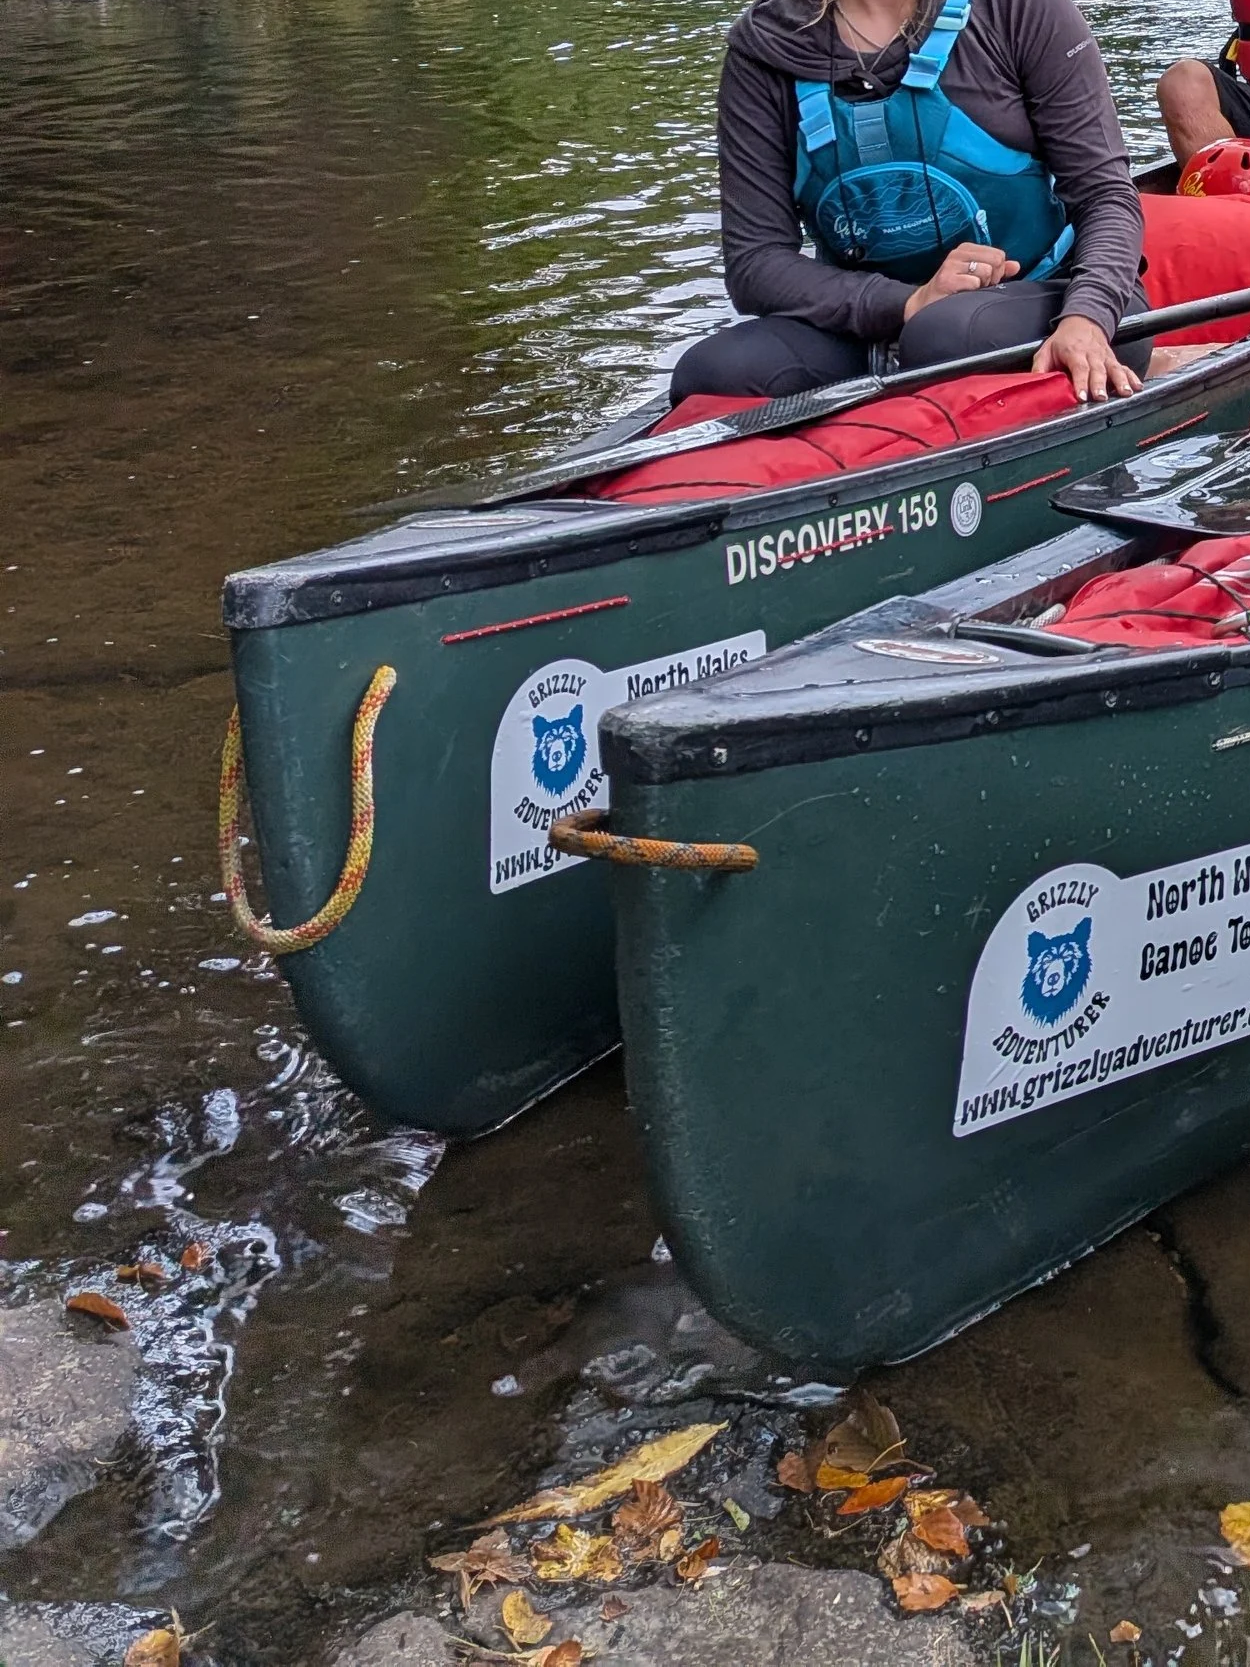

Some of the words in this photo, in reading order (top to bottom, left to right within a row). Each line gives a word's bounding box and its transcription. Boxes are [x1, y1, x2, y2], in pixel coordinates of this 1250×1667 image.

[726, 502, 889, 585] DISCOVERY
[898, 491, 939, 534] 158
[528, 673, 587, 709] GRIZZLY
[627, 662, 690, 701] North
[697, 648, 749, 679] Wales
[1026, 880, 1099, 923] GRIZZLY
[1146, 865, 1225, 921] North
[1139, 931, 1218, 981] Canoe
[992, 990, 1110, 1065] ADVENTURER
